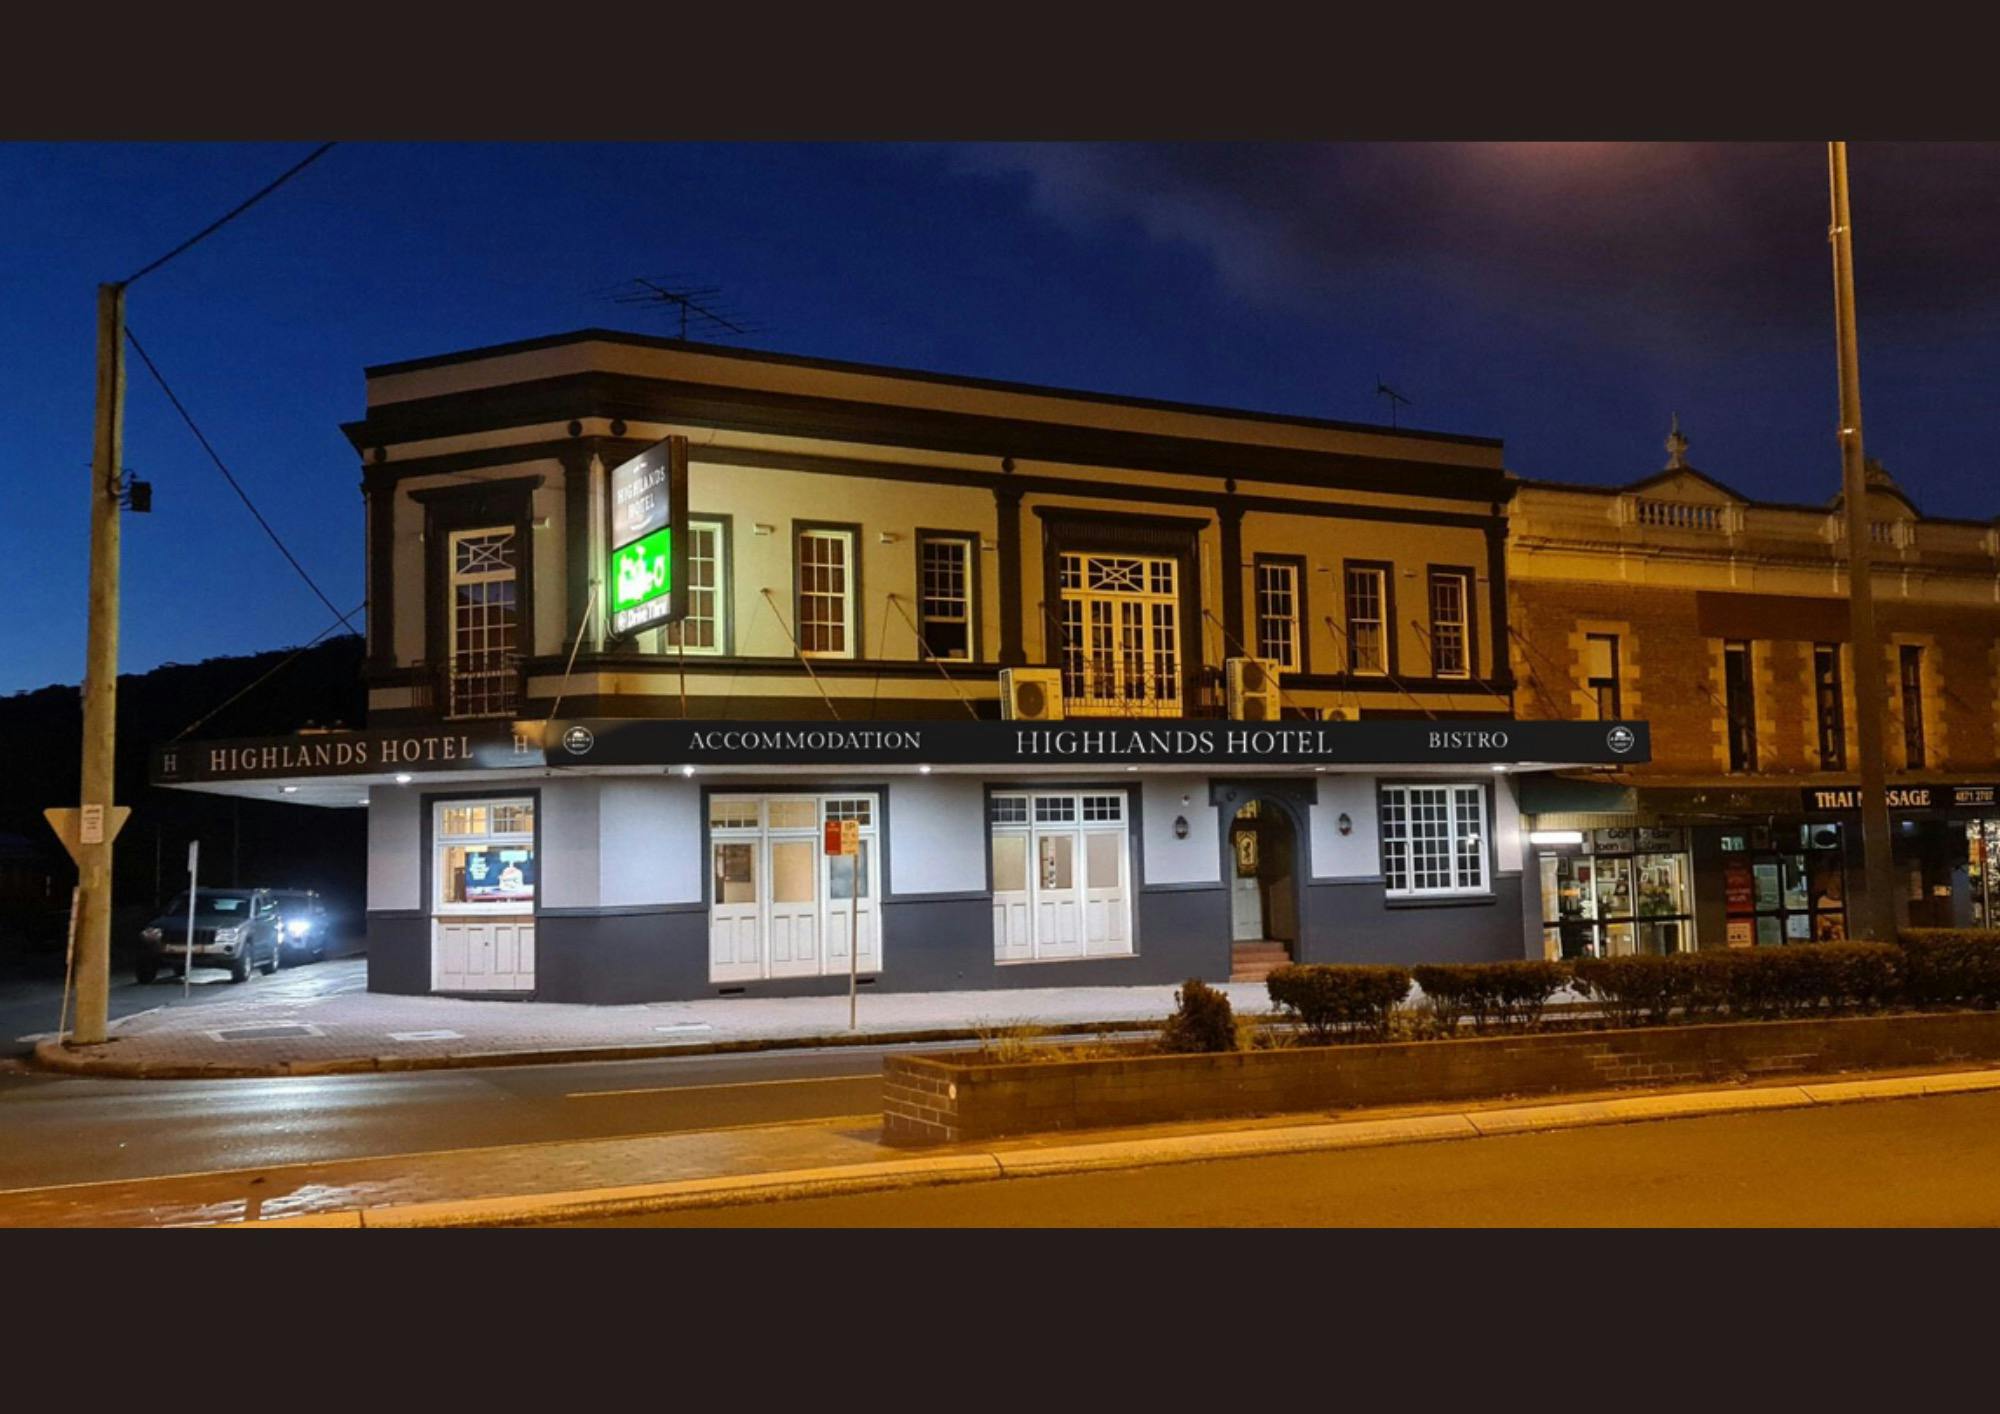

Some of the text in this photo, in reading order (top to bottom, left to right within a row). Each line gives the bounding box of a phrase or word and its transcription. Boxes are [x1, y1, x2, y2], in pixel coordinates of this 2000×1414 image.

[617, 466, 666, 505] HIGHLANDS
[628, 493, 656, 519] HOTEL
[513, 734, 529, 754] H
[689, 731, 921, 750] ACCOMMODATION
[1014, 731, 1333, 755] HIGHLANDS HOTEL
[1428, 731, 1509, 749] BISTRO
[163, 754, 177, 772] H
[210, 735, 475, 772] HIGHLANDS HOTEL
[1815, 789, 1931, 808] THAI SAGE
